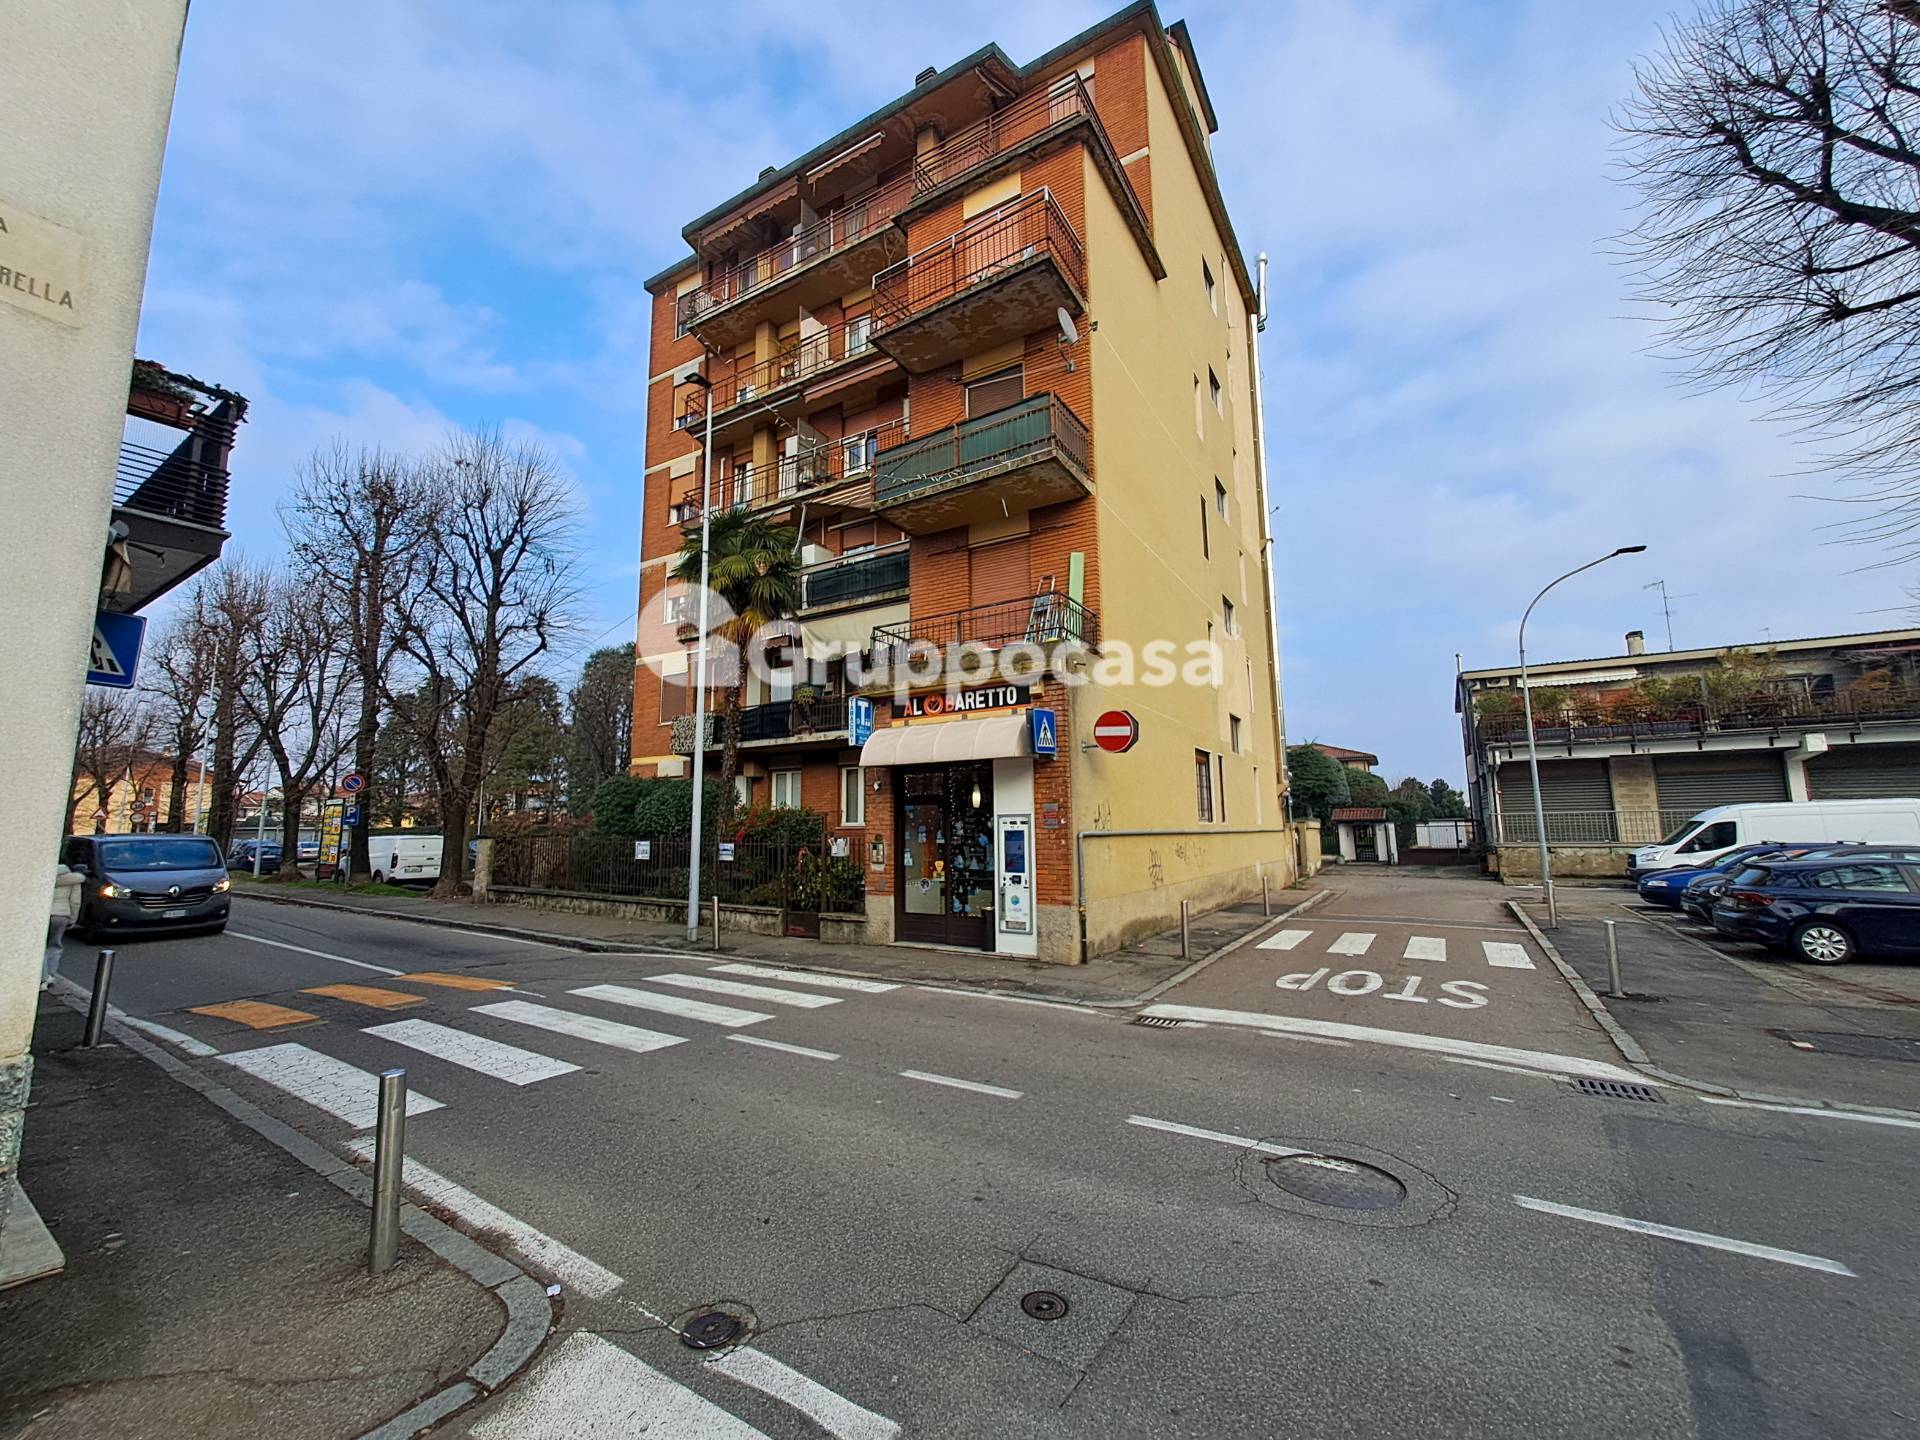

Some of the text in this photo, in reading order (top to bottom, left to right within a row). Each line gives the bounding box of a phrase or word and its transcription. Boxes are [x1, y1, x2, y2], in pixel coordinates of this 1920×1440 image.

[945, 686, 1018, 712] BARETTO
[347, 807, 357, 817] P
[1275, 967, 1490, 1009] STOP
